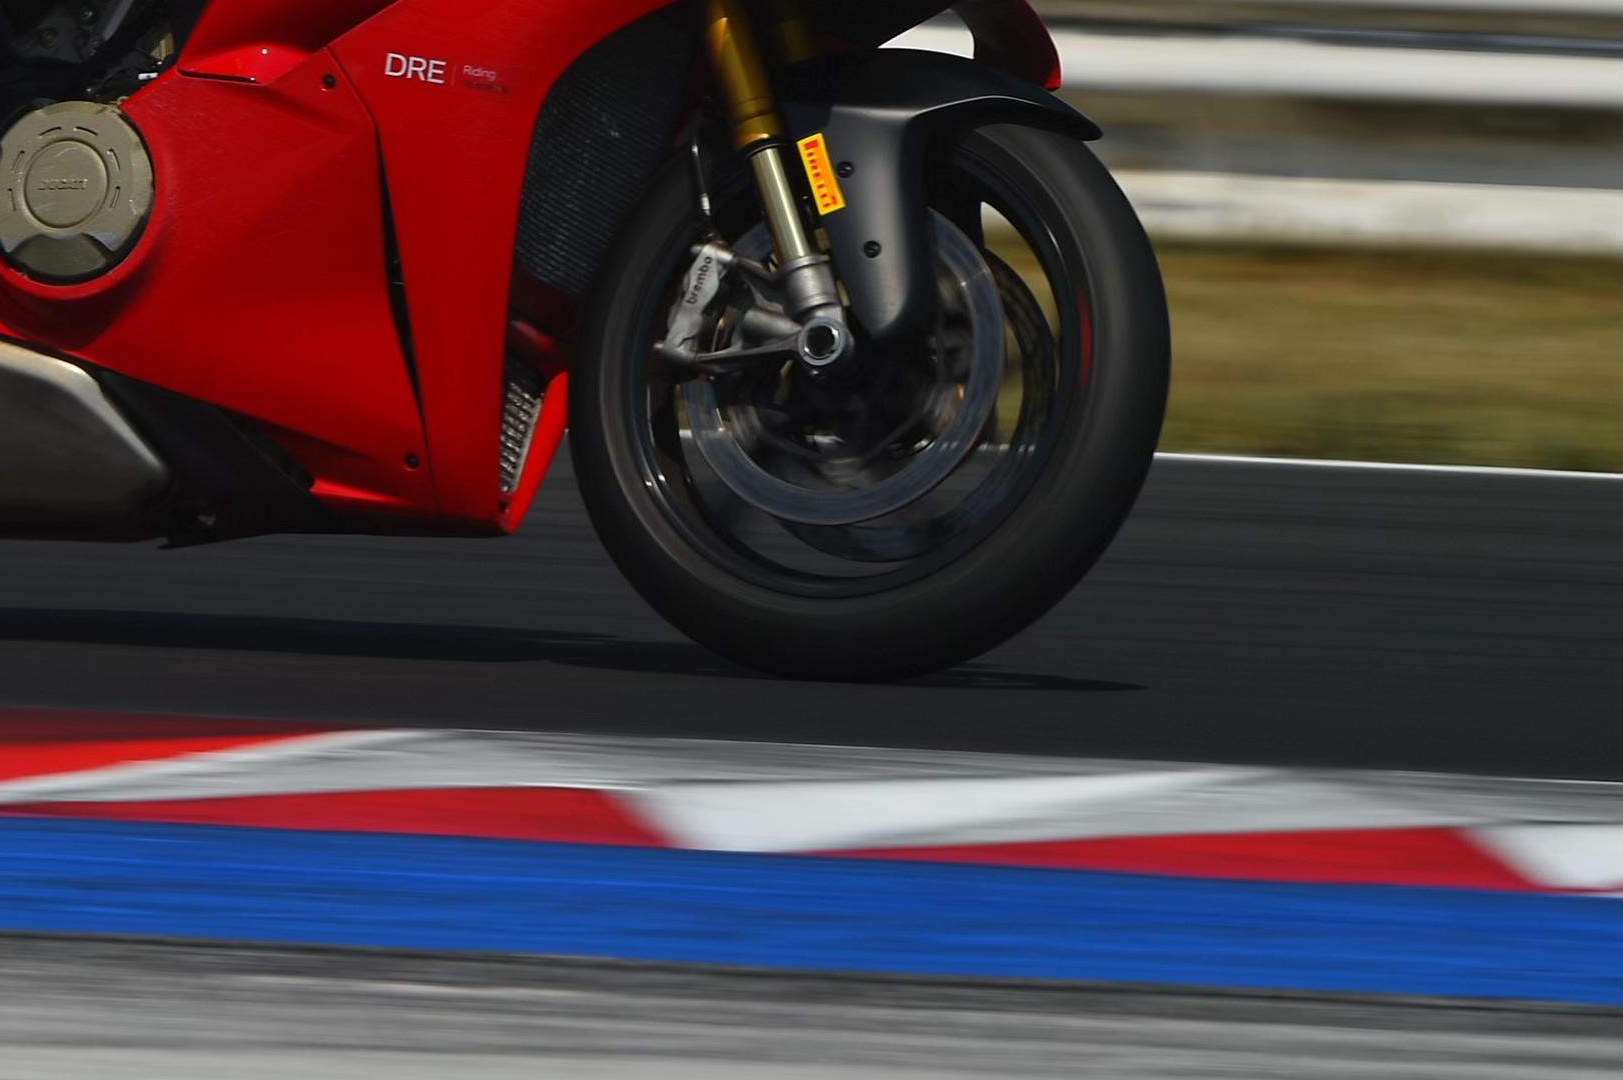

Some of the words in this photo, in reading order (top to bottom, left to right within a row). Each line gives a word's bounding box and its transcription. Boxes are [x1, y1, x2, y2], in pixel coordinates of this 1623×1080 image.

[384, 52, 447, 84] DRE
[462, 64, 497, 82] Riding
[686, 256, 713, 305] brembo
